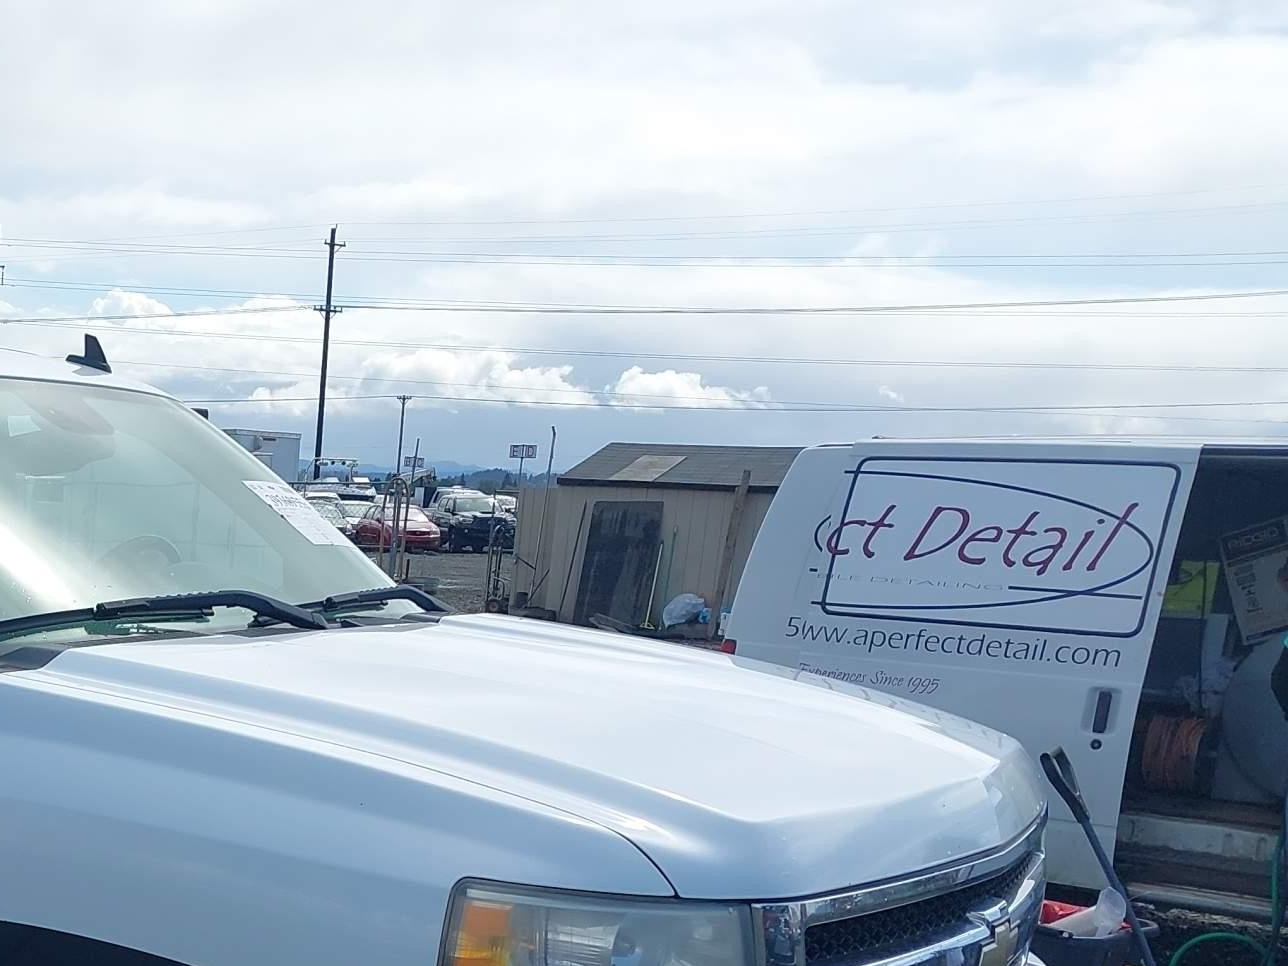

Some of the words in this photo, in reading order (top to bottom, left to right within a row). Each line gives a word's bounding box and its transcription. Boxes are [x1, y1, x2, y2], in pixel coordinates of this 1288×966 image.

[827, 504, 895, 559] ct
[903, 502, 1140, 576] Detail
[870, 670, 904, 686] Since
[907, 676, 941, 695] 1995
